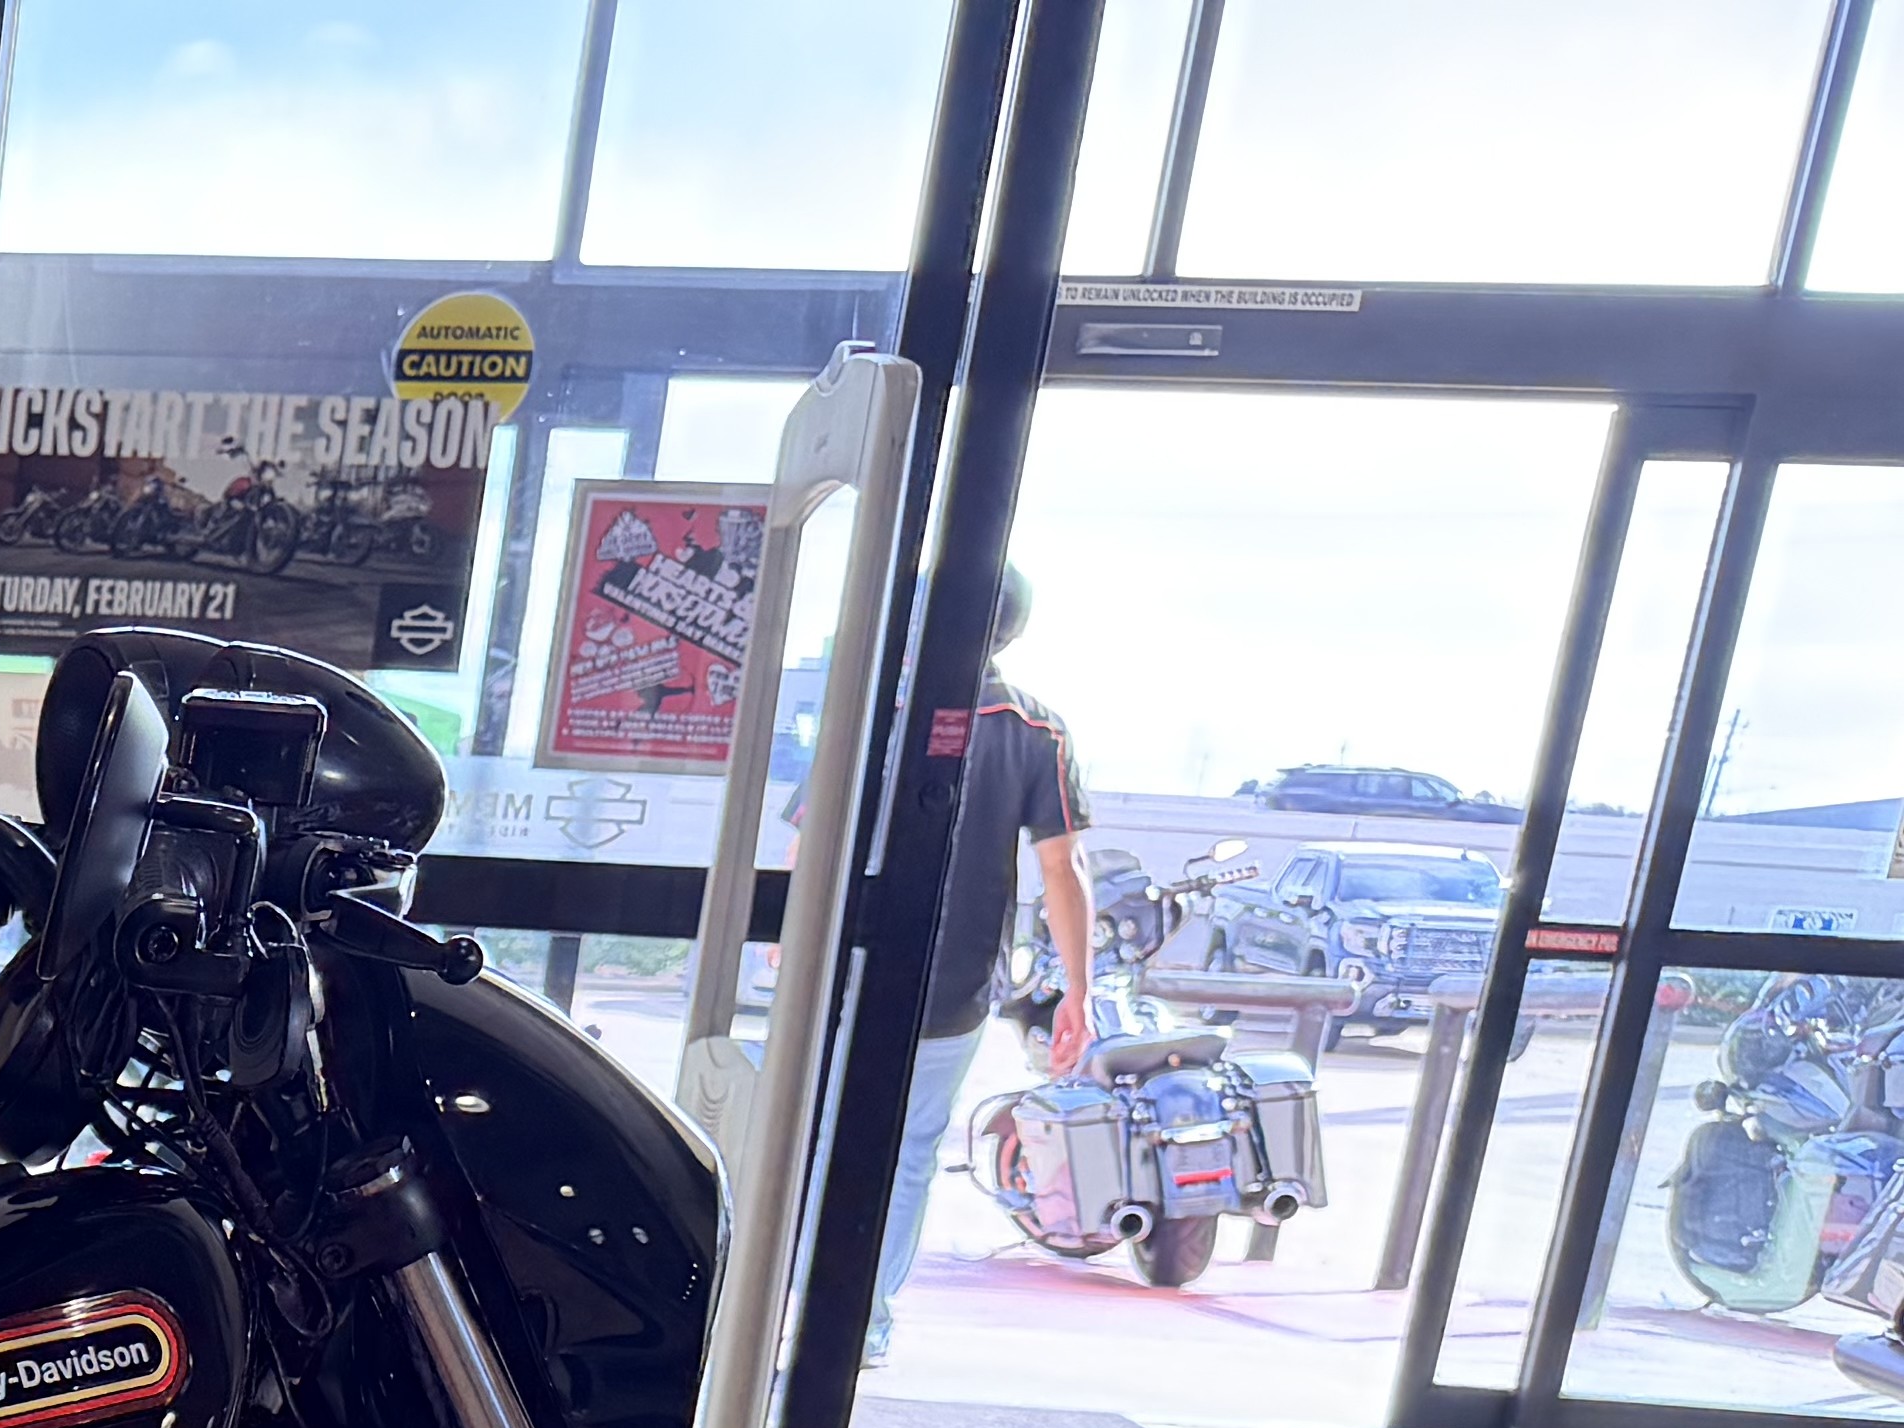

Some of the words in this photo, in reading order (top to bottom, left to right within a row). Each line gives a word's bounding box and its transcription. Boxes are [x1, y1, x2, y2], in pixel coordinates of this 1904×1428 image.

[1122, 288, 1178, 303] UNLOCKED
[1236, 290, 1286, 305] BUILDING
[1301, 291, 1355, 307] OCCUPIED
[416, 325, 521, 341] AUTOMATIC
[401, 354, 528, 378] CAUTION
[220, 392, 308, 464] THE
[313, 393, 501, 470] SEASON
[85, 578, 207, 619] FEBRUARY
[205, 582, 237, 620] 21
